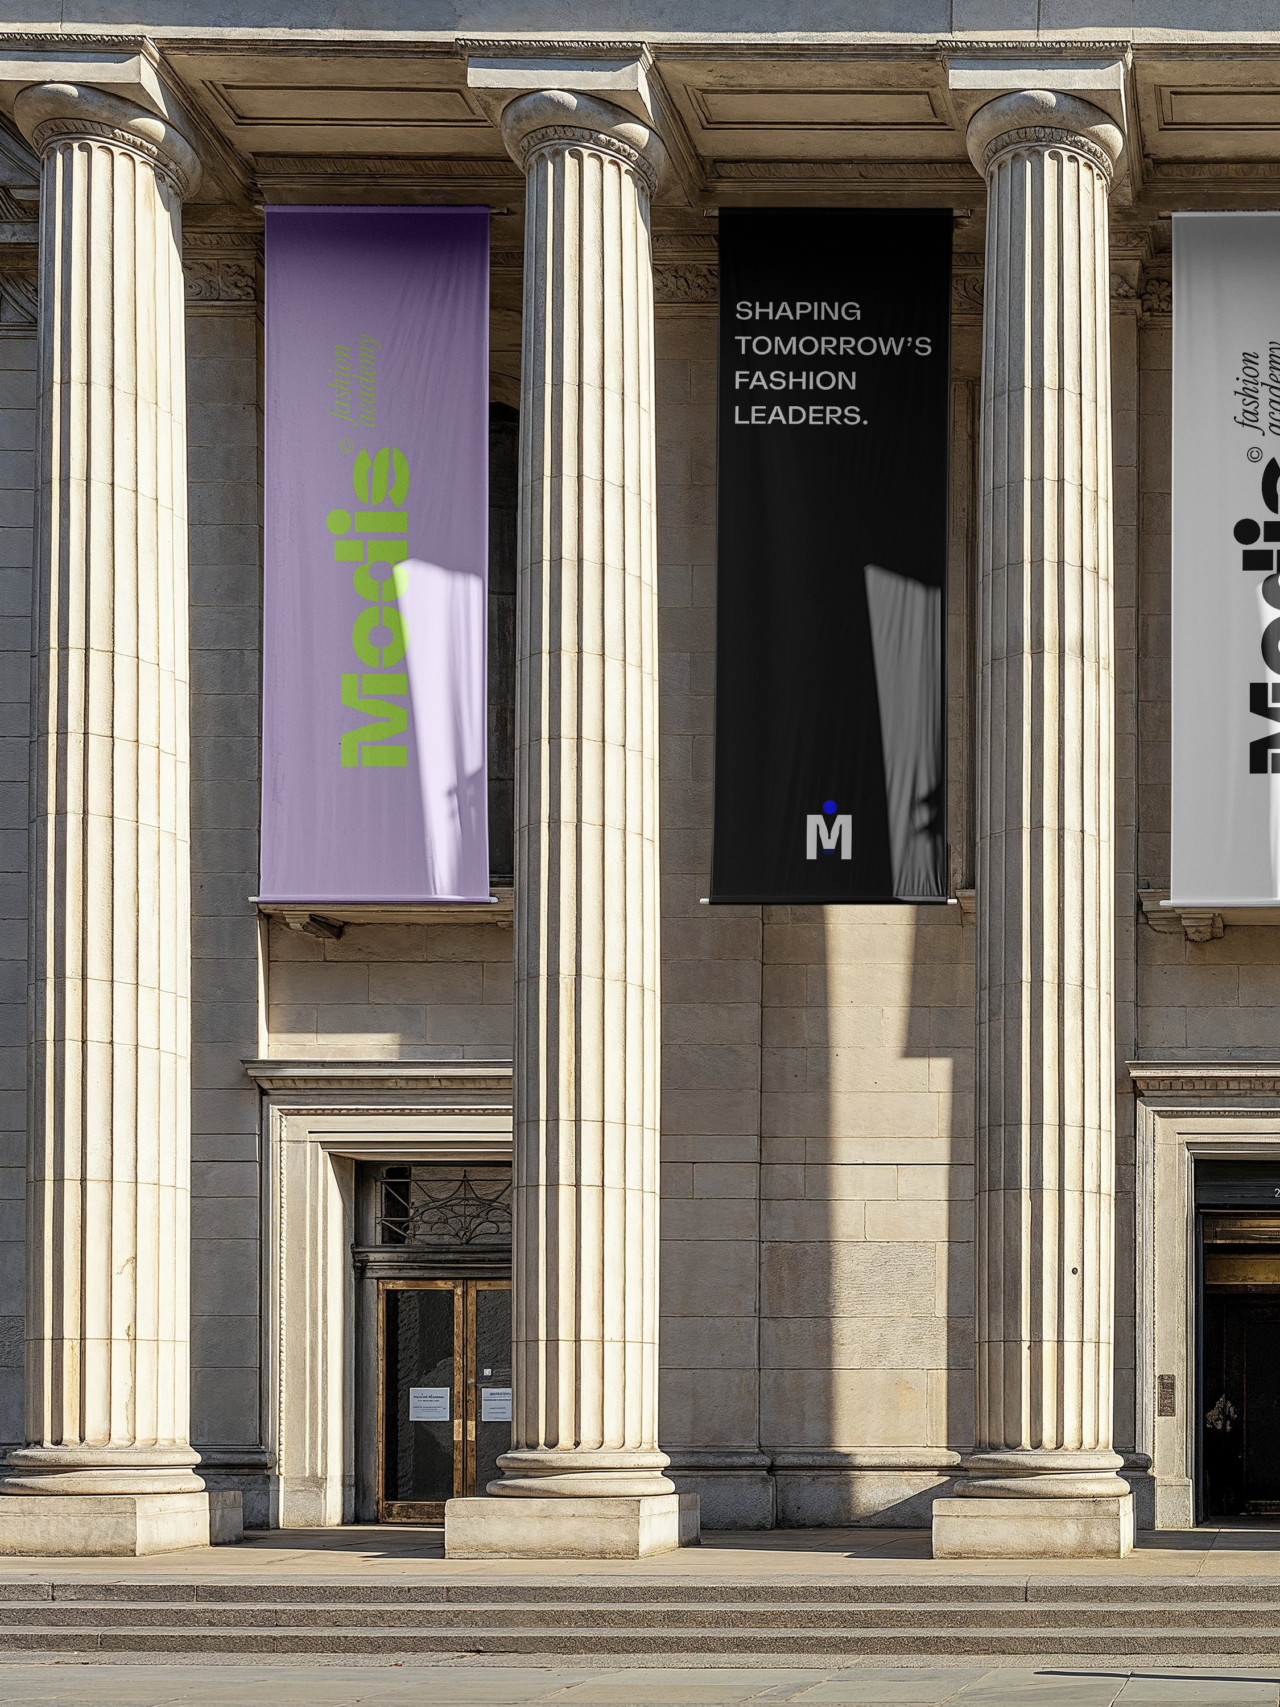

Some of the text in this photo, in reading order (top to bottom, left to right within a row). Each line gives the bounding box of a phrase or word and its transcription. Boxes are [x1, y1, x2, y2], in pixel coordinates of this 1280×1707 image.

[735, 301, 861, 321] SHAPING
[735, 336, 932, 356] TOMORROW’S
[327, 344, 356, 427] fashion
[352, 334, 382, 428] academy
[735, 371, 857, 390] FASHION
[1234, 352, 1265, 436] fashion
[734, 405, 869, 425] LEADERS.
[326, 446, 410, 767] Modis
